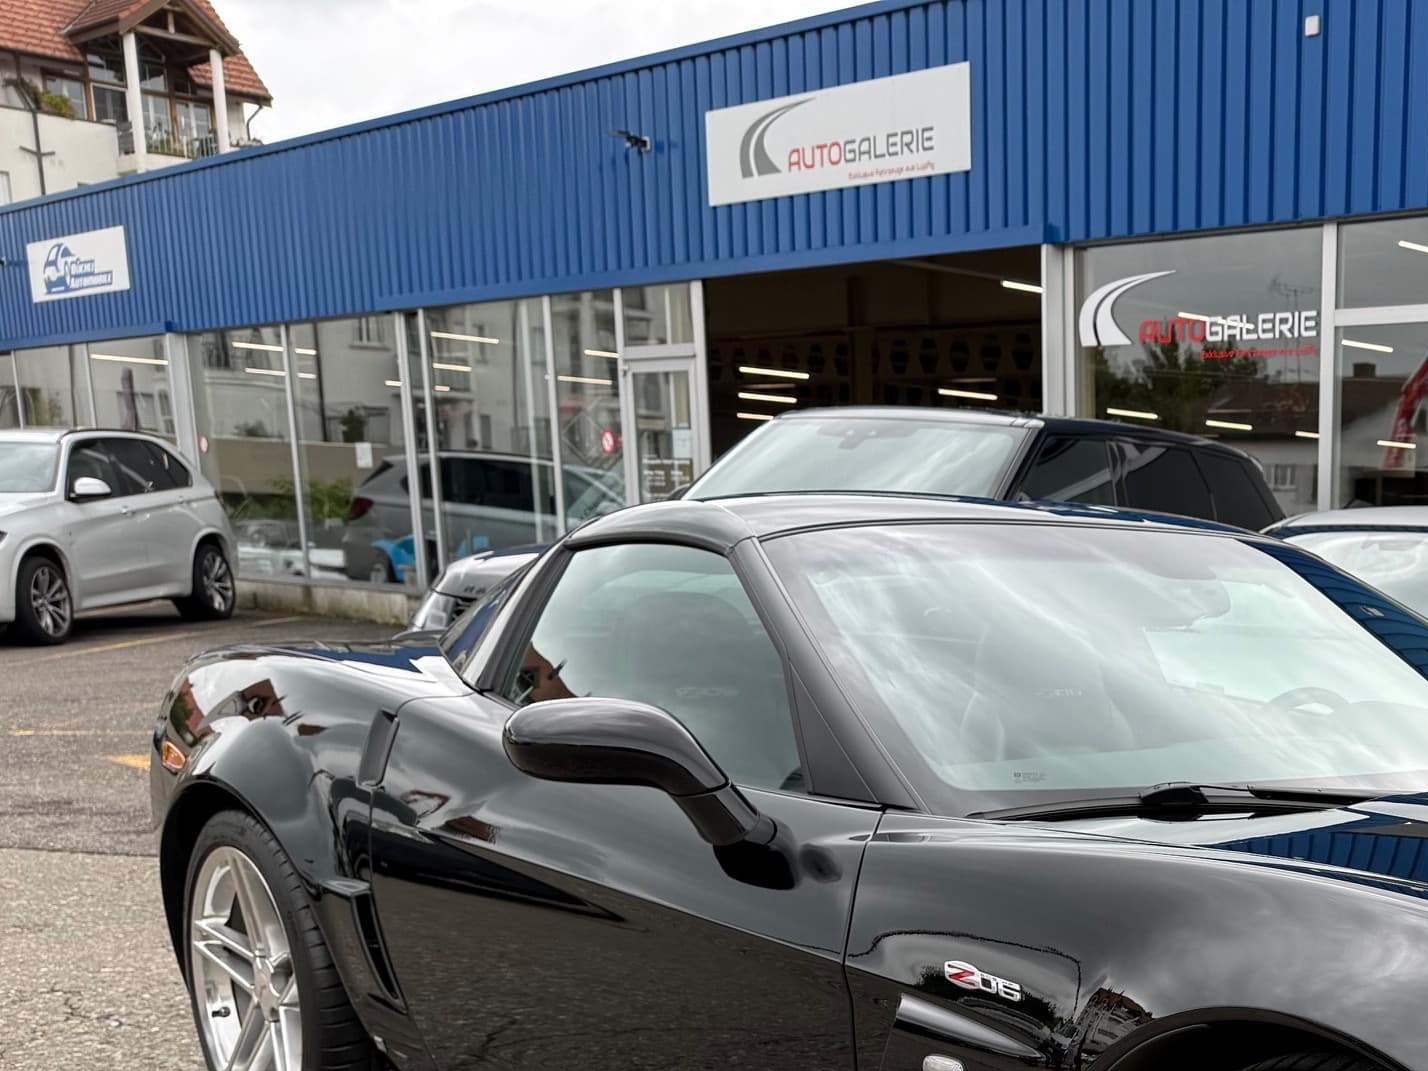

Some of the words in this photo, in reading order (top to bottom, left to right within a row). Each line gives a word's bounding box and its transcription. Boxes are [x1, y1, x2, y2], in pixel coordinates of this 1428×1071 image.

[788, 126, 935, 173] AUTOGALERIE
[1137, 310, 1318, 345] AUTOGALERIE
[944, 960, 1021, 1001] Z06
